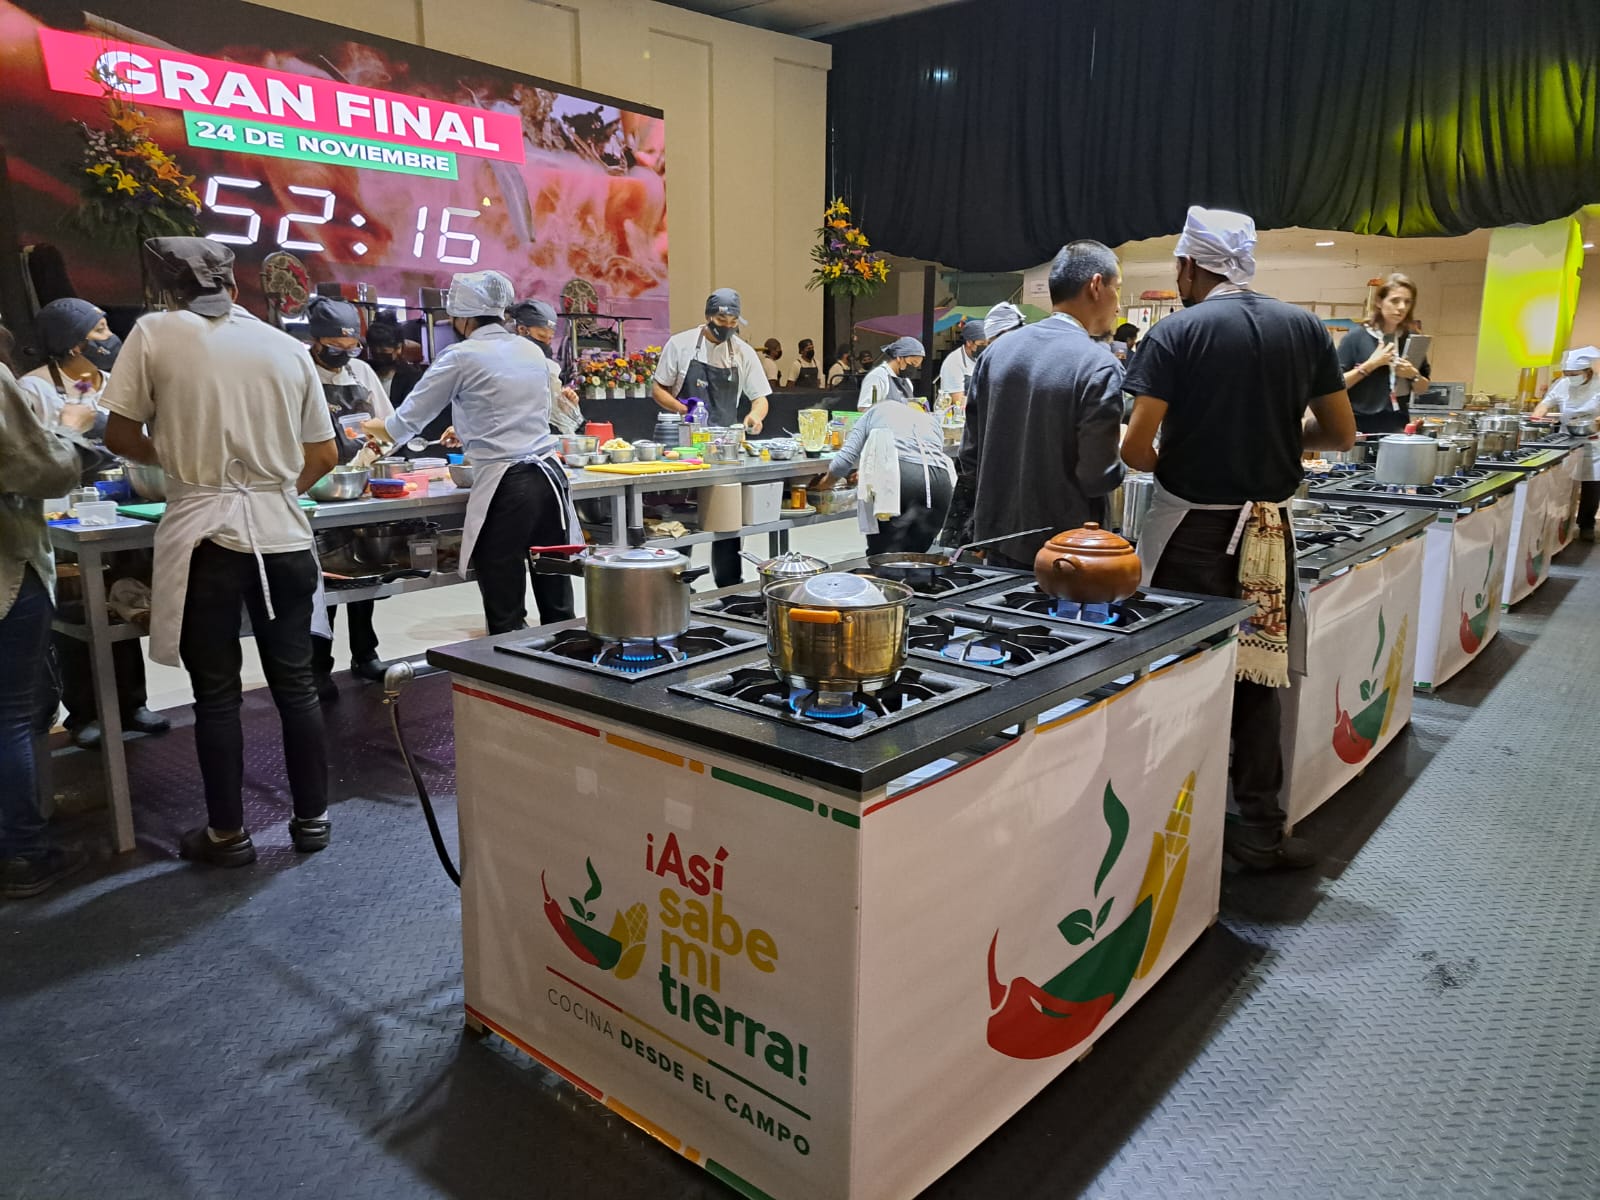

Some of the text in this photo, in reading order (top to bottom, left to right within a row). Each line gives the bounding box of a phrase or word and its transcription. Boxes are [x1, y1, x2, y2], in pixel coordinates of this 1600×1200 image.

[95, 50, 500, 152] GRAN FINAL
[196, 121, 450, 172] 24 DE NOVIEMBRE
[659, 887, 778, 974] sabe
[547, 988, 811, 1156] COCINA DESDE EL CAMPO
